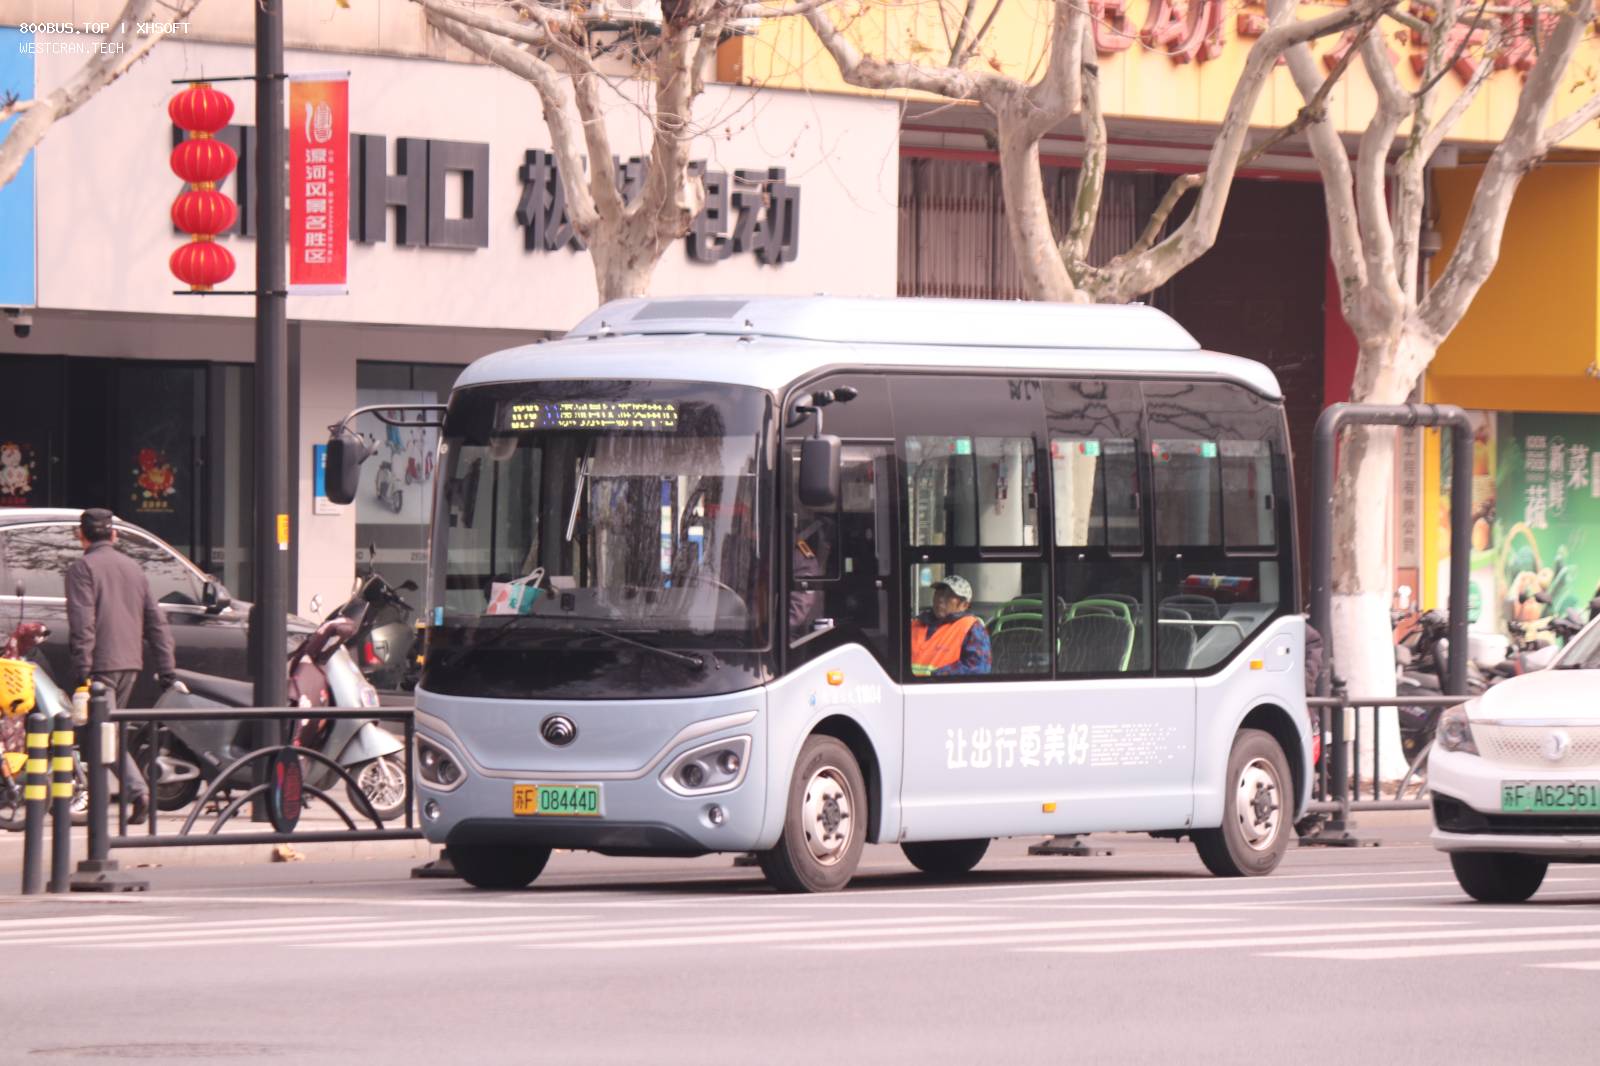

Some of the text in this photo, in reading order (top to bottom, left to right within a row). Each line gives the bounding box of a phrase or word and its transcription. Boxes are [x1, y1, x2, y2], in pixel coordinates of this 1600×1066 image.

[304, 148, 327, 264] 濠河风景名胜区
[945, 723, 1090, 769] 让出行更美好
[541, 790, 597, 810] 08444D
[1533, 785, 1598, 806] A62561
